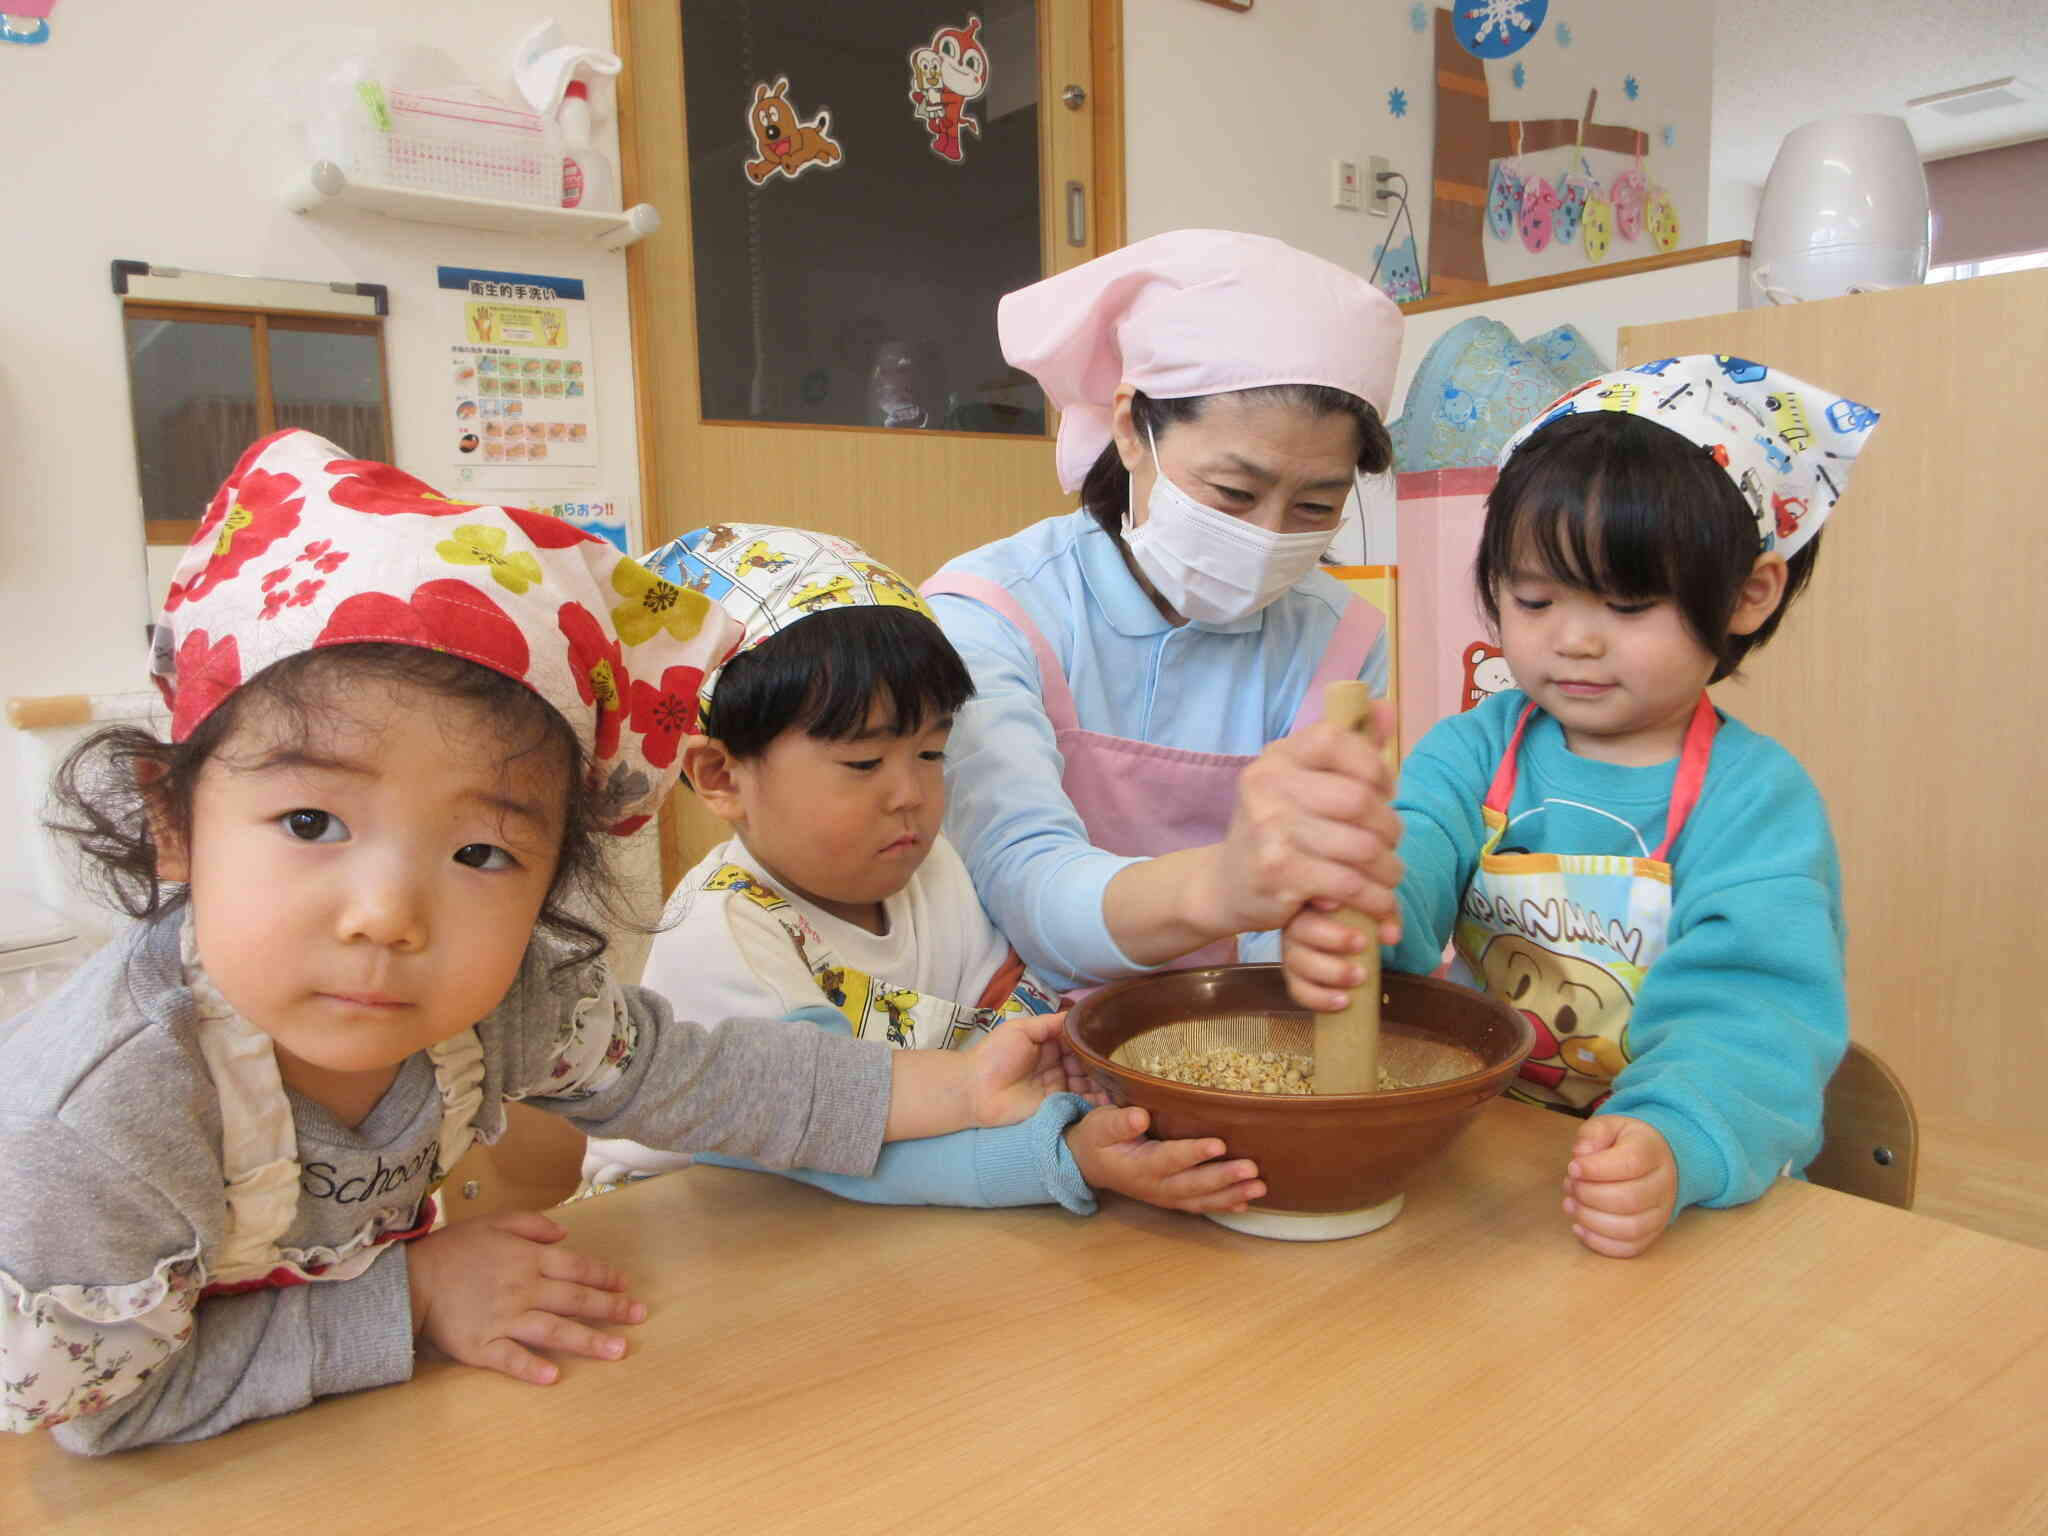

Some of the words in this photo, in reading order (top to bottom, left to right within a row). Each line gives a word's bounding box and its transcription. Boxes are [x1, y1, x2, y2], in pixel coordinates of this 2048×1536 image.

[470, 281, 557, 301] 衛生的手洗い
